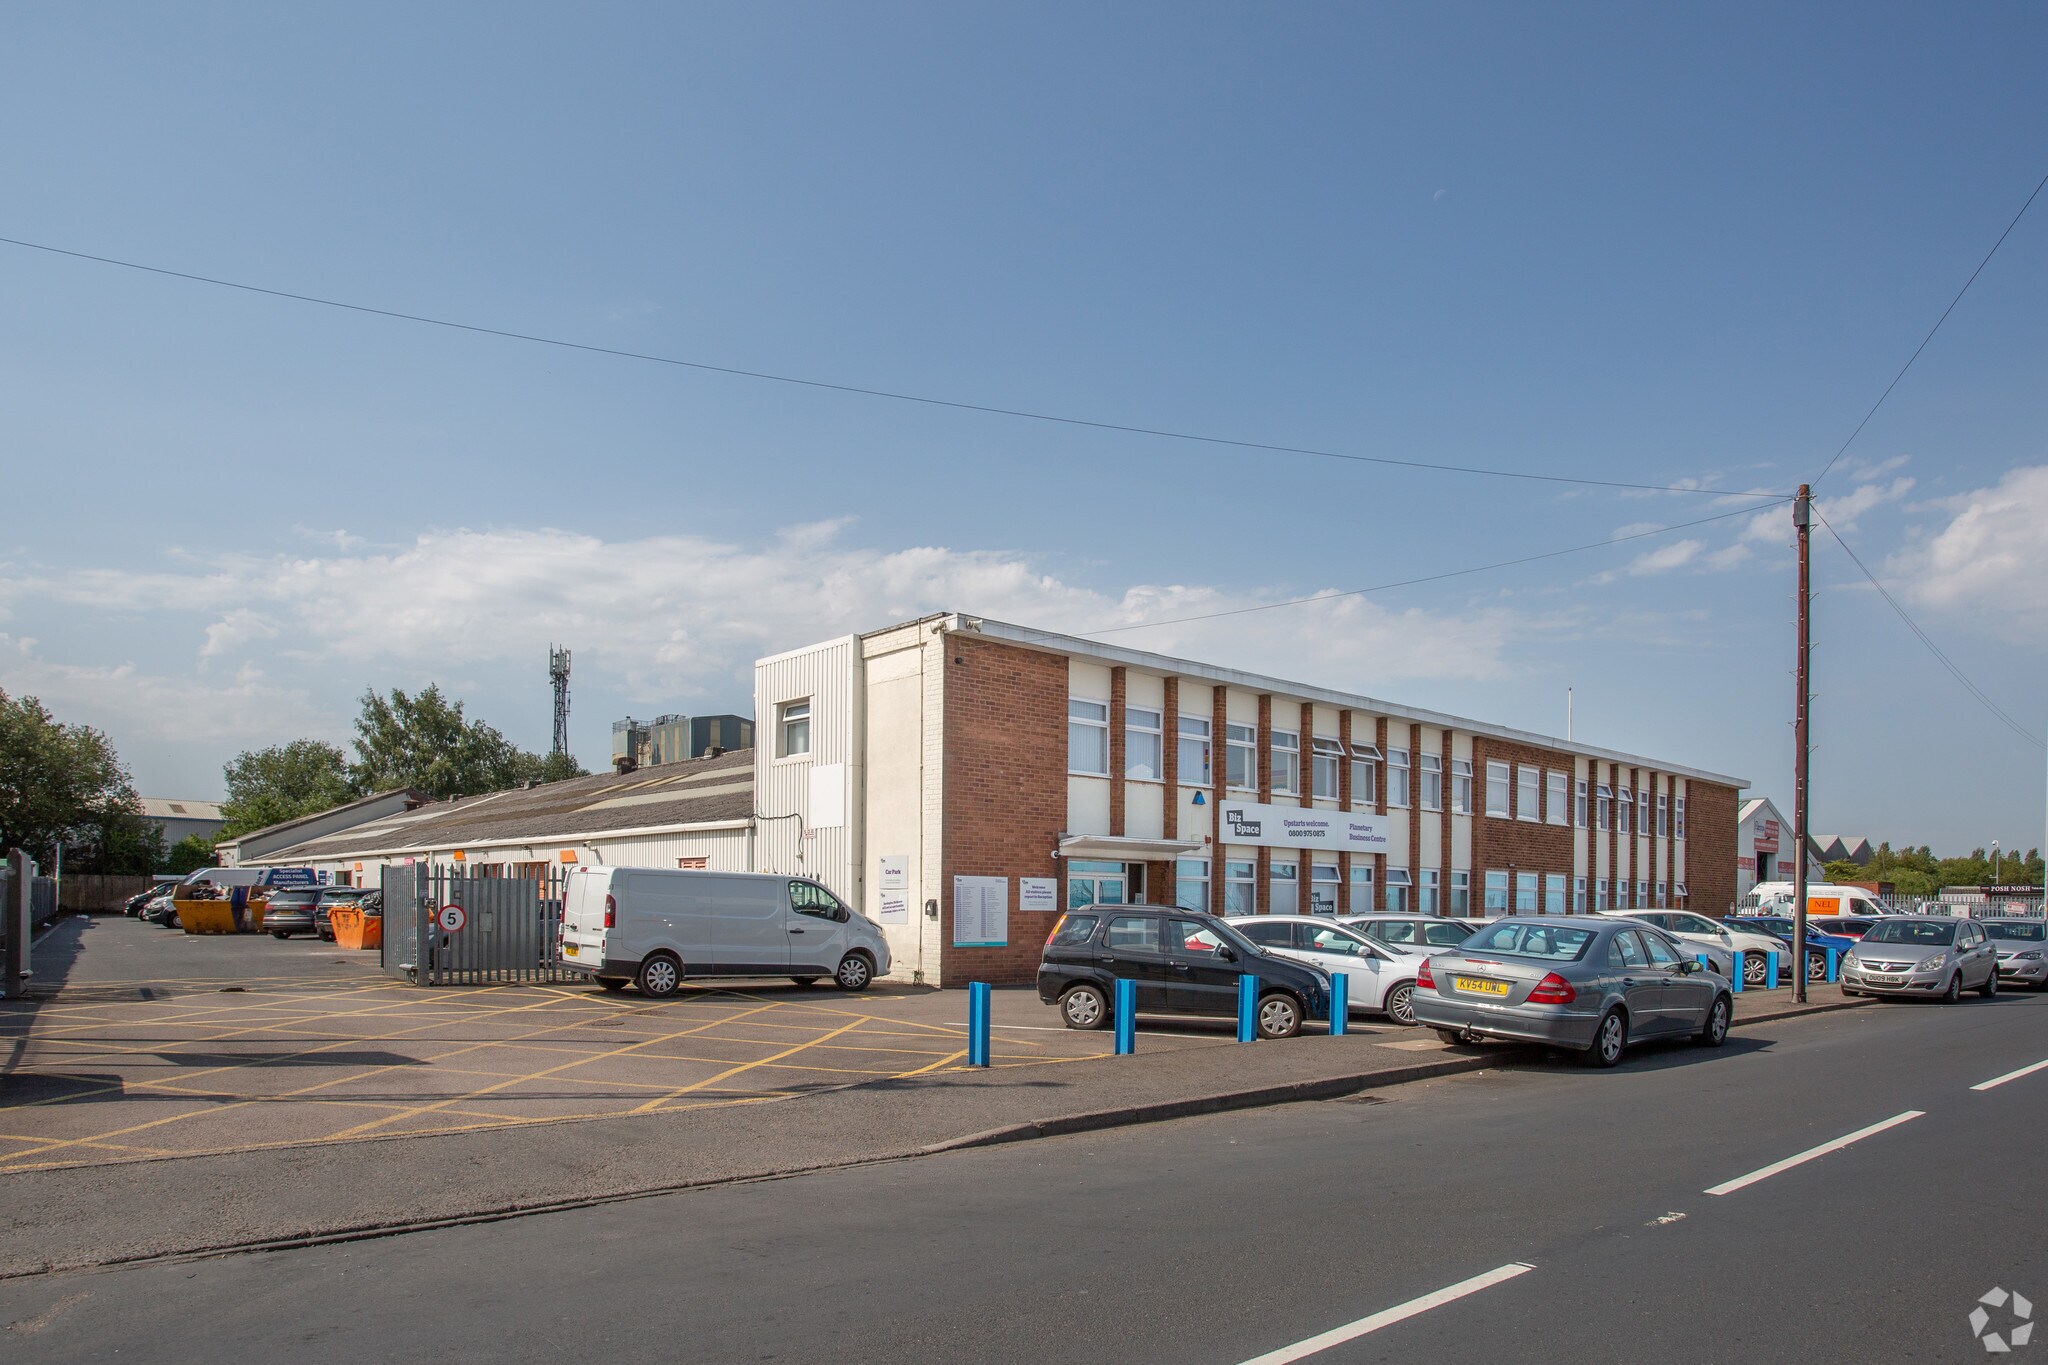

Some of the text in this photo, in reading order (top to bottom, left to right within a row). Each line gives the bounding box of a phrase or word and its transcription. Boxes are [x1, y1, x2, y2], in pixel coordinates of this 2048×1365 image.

[1228, 812, 1242, 823] Biz
[1283, 819, 1306, 828] Upstarts
[1349, 823, 1373, 833] Planetary
[1236, 823, 1260, 835] Space
[1288, 829, 1326, 837] 0800 975 0875
[1349, 833, 1387, 843] Business Centre
[1315, 902, 1333, 912] Space
[447, 912, 457, 926] 5
[1459, 979, 1483, 990] KV54
